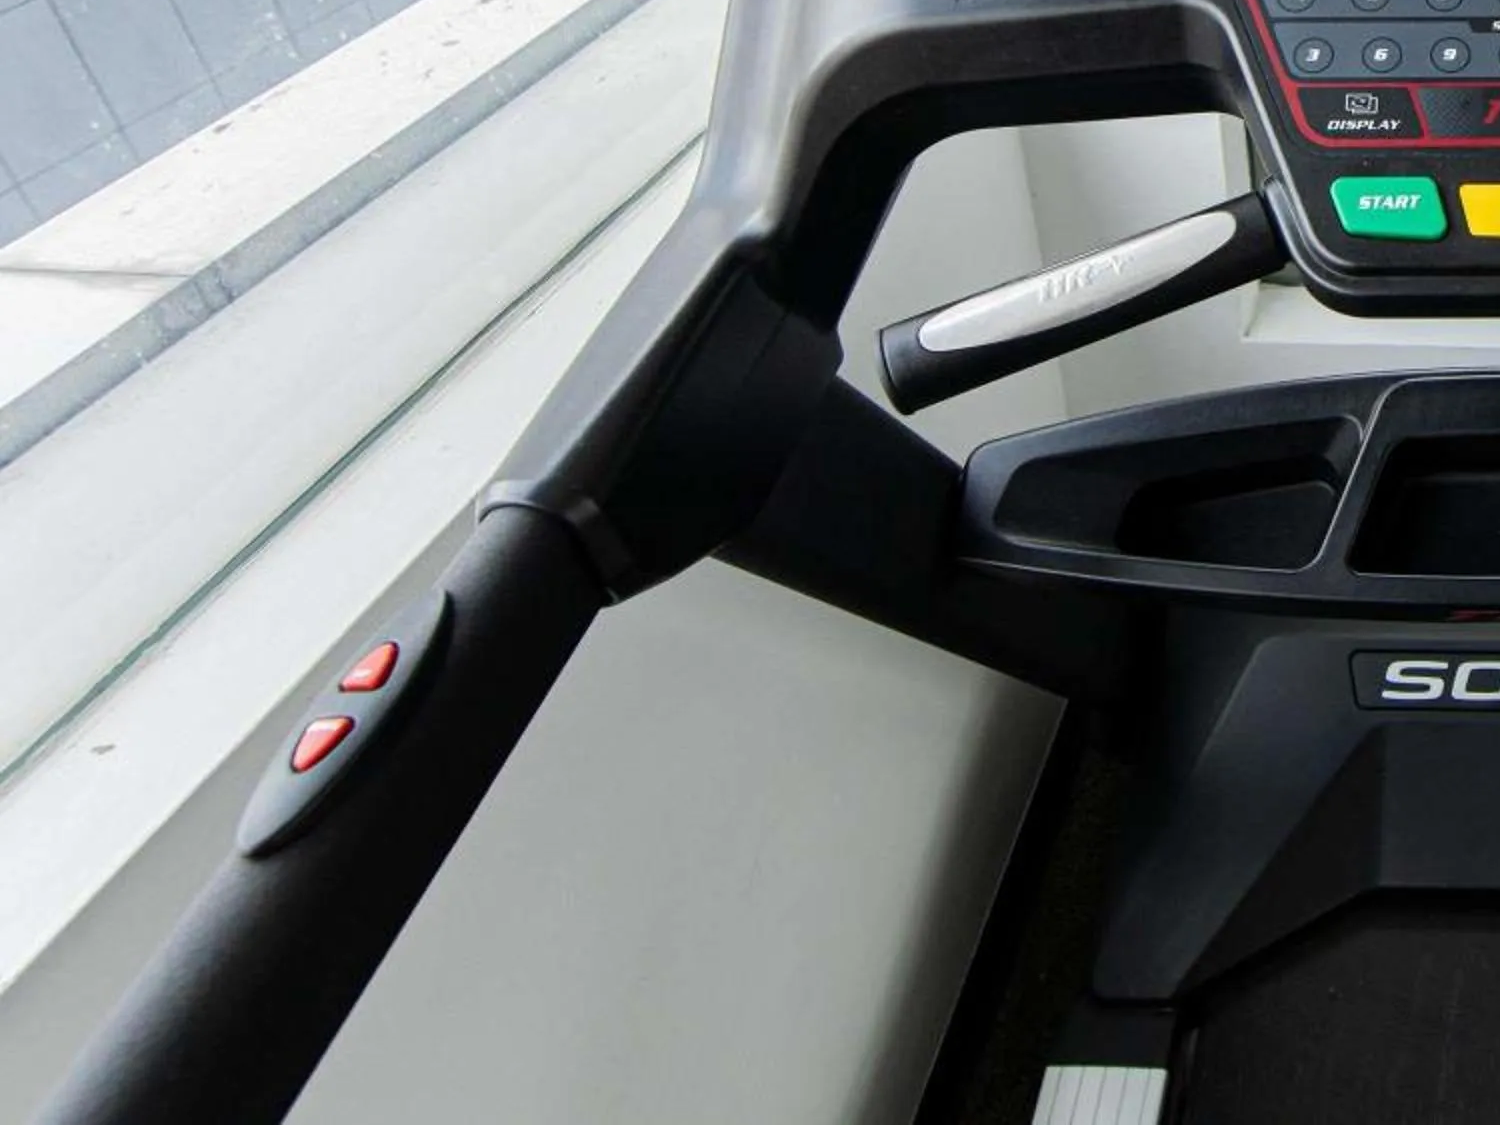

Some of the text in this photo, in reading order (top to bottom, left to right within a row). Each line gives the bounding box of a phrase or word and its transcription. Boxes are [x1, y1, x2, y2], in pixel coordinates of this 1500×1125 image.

[1305, 48, 1321, 62] 3
[1373, 48, 1389, 62] 6
[1442, 47, 1458, 61] 9
[1326, 118, 1402, 132] DISPLAY
[1359, 194, 1422, 210] START
